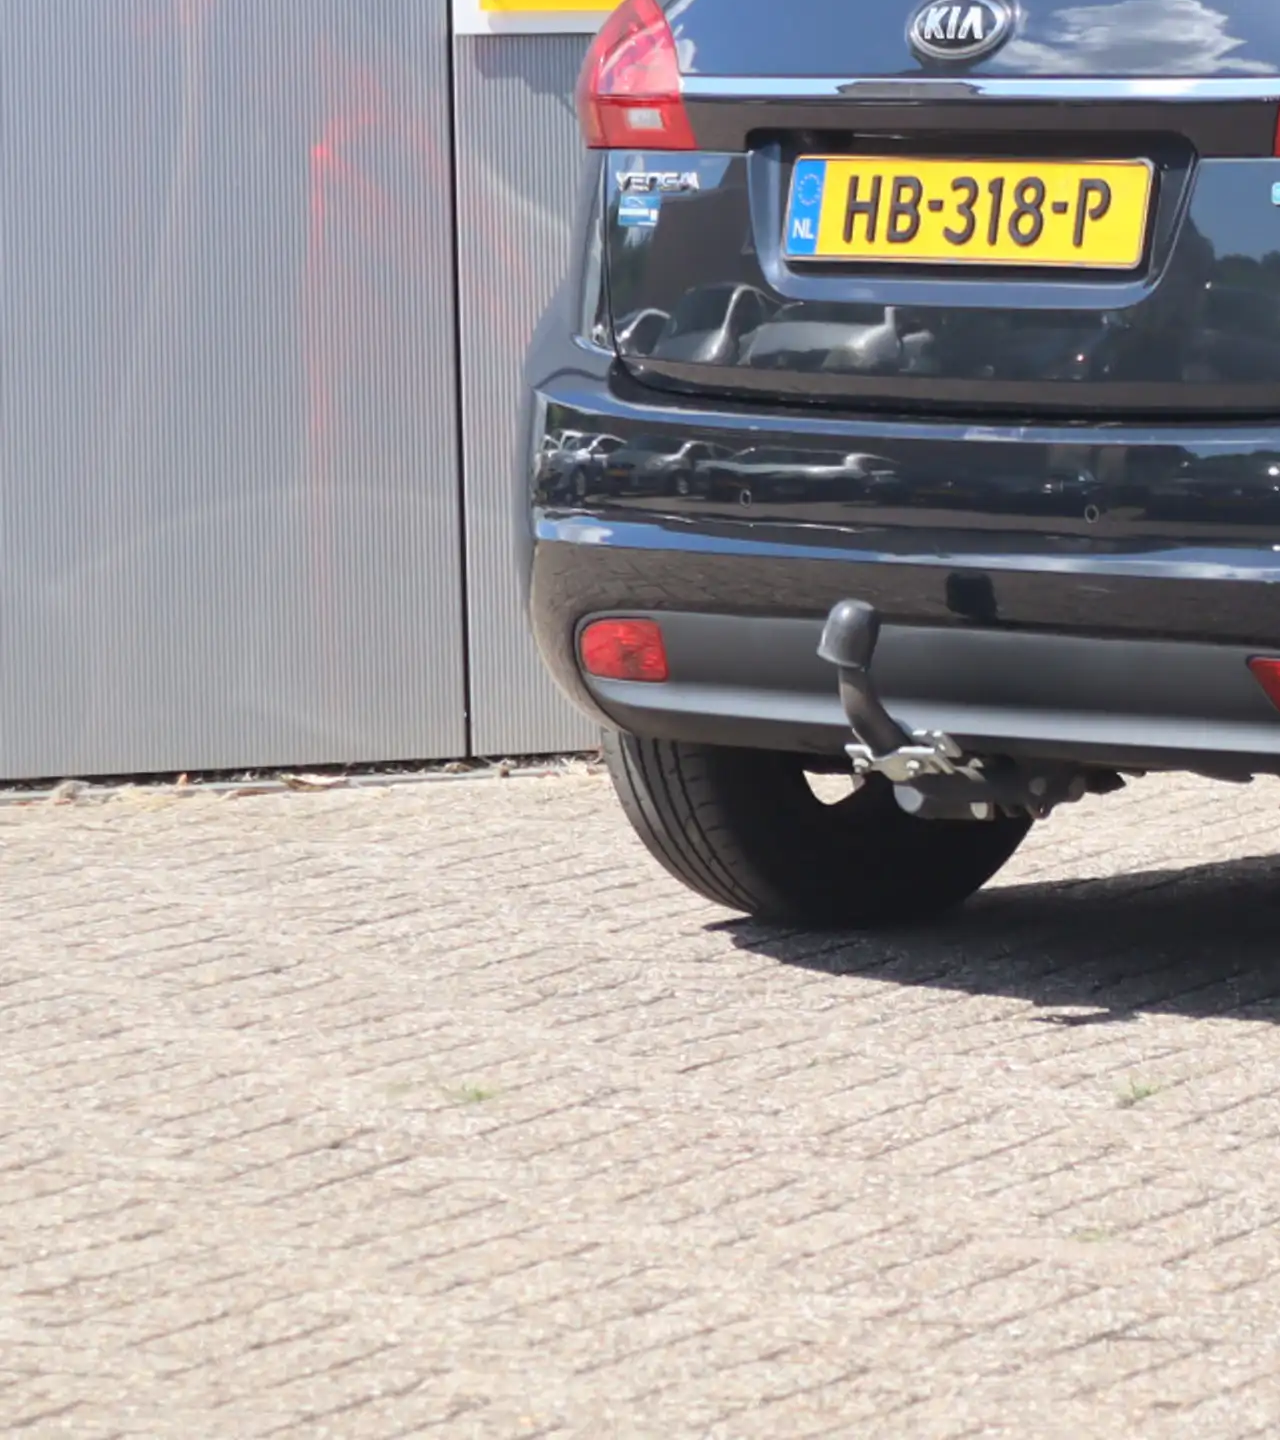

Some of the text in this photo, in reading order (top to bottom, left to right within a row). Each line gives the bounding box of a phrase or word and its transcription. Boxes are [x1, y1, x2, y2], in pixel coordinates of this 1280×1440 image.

[924, 5, 984, 40] KIA
[615, 171, 700, 192] VENGA
[842, 174, 1112, 249] HB-318-P
[792, 218, 814, 241] NL
